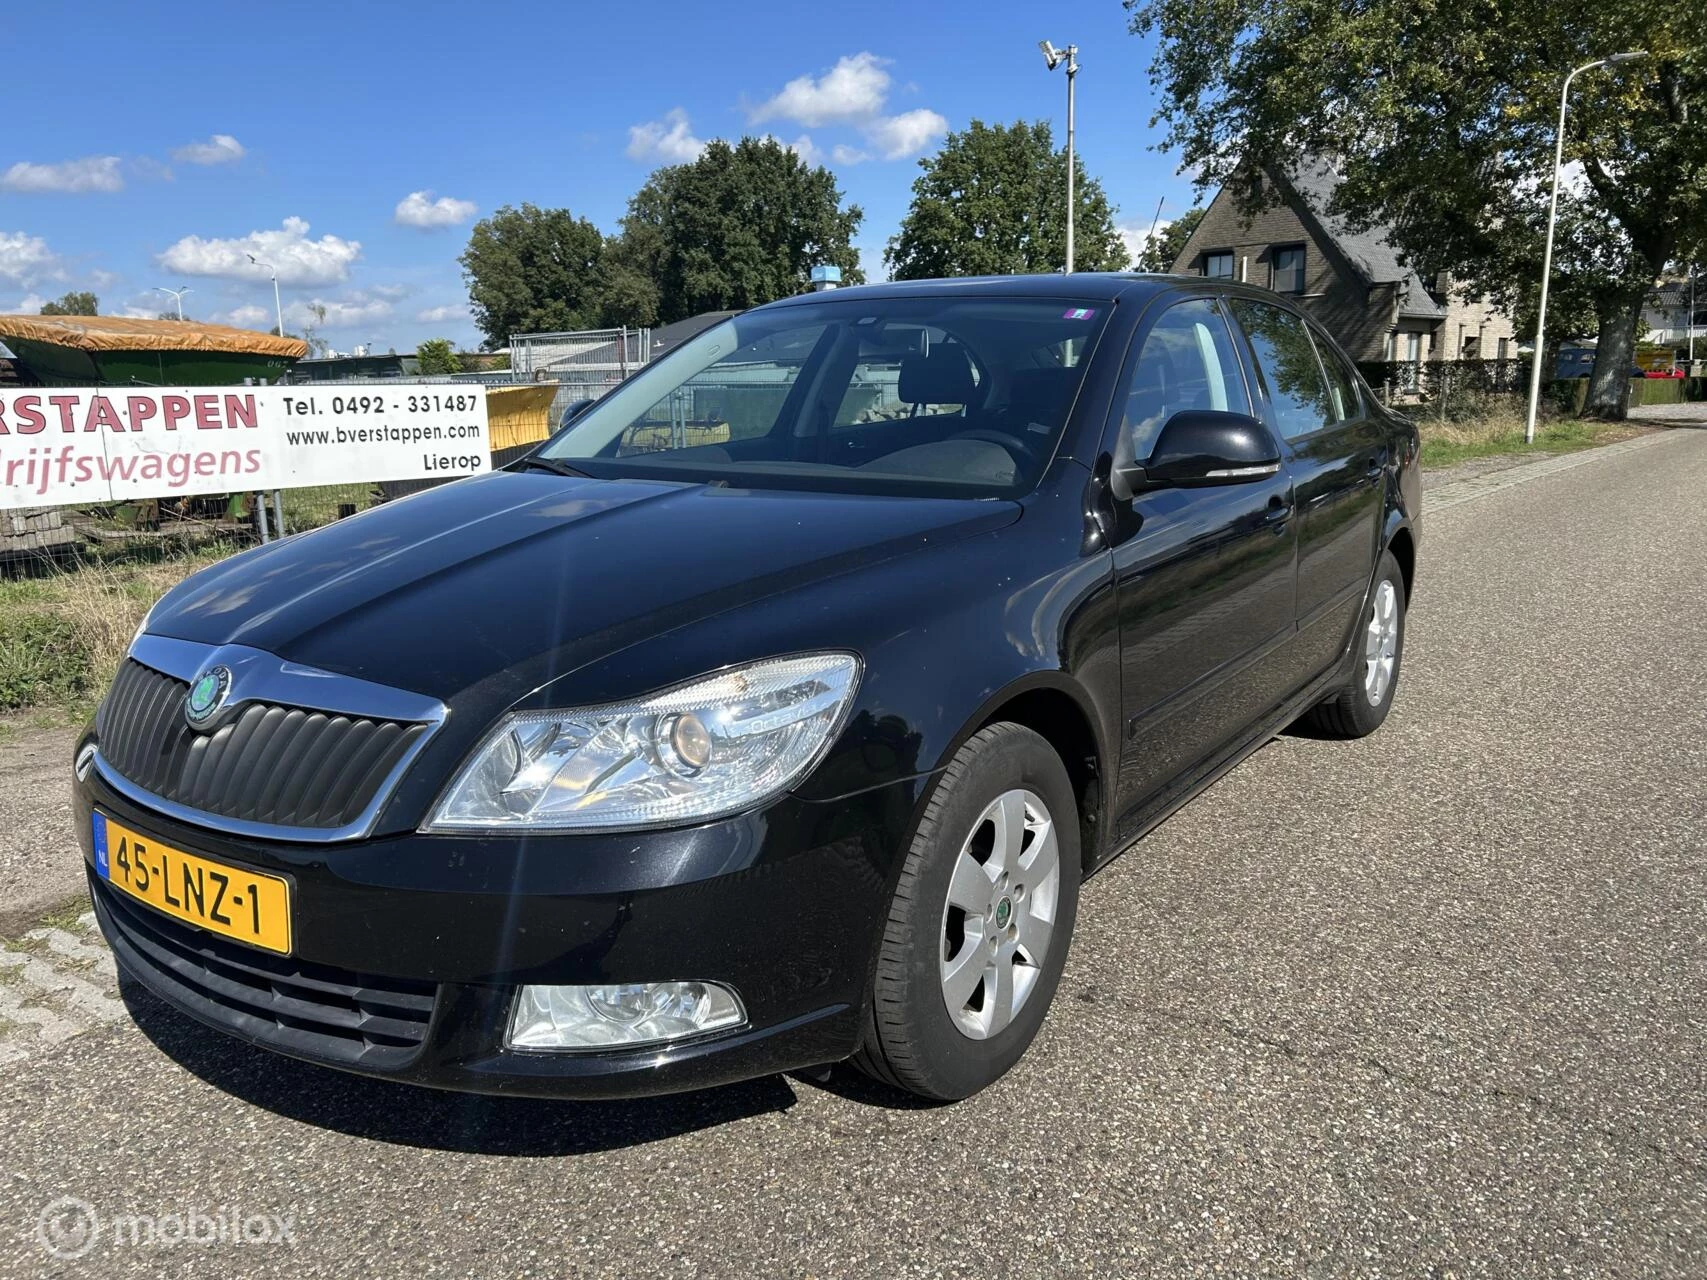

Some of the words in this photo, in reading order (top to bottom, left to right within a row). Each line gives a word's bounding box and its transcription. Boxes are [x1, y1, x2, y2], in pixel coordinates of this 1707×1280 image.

[283, 397, 323, 415] Tel.
[332, 396, 385, 415] 0492
[408, 395, 477, 413] 331487
[286, 424, 480, 445] www.bverstappen.com
[0, 446, 261, 495] rijfswagens
[424, 453, 481, 471] Lierop
[98, 849, 108, 867] NL
[116, 836, 260, 934] 45-LNZ-1
